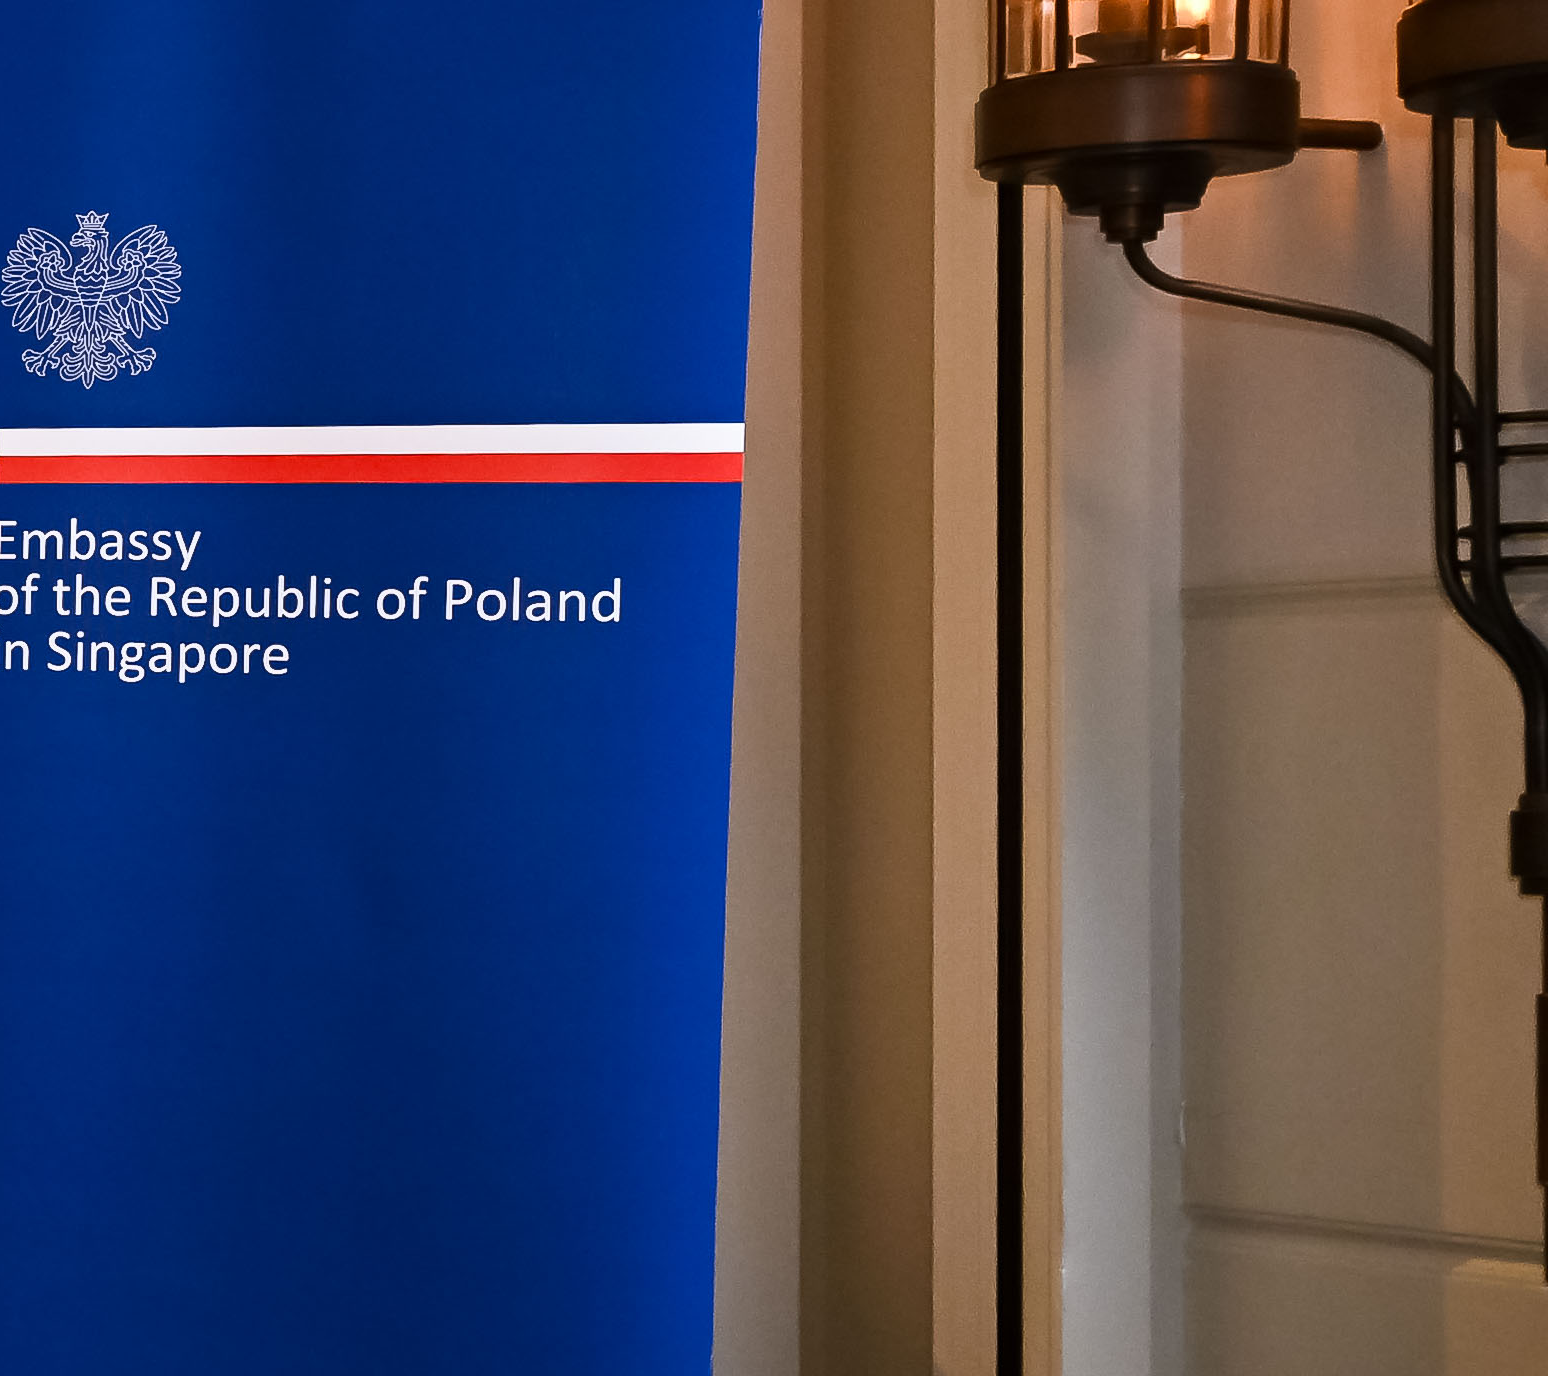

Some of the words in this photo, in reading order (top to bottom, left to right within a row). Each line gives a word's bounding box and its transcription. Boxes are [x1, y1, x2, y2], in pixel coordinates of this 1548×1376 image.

[53, 574, 130, 616] the
[151, 575, 359, 627] Republic
[377, 576, 428, 619] of
[446, 577, 620, 622] Poland
[47, 631, 289, 683] Singapore
